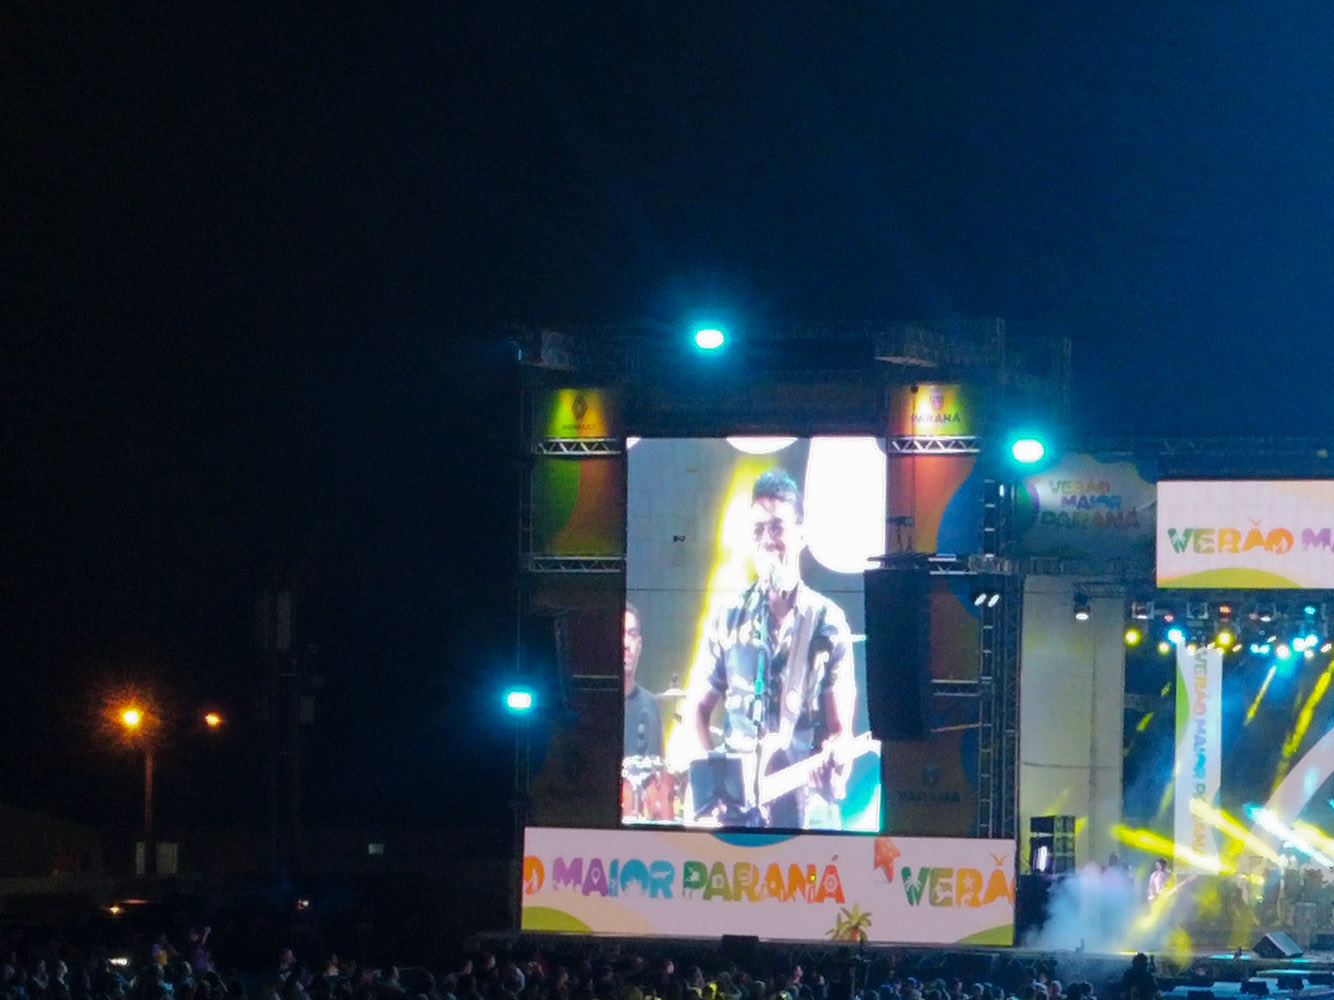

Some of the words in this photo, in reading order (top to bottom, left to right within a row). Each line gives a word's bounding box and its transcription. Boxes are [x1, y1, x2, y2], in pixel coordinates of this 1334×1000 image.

[1167, 519, 1294, 554] VERÃO
[552, 857, 676, 900] MAIOR
[682, 854, 846, 905] PARANÁ
[901, 851, 1015, 908] VERÃ
